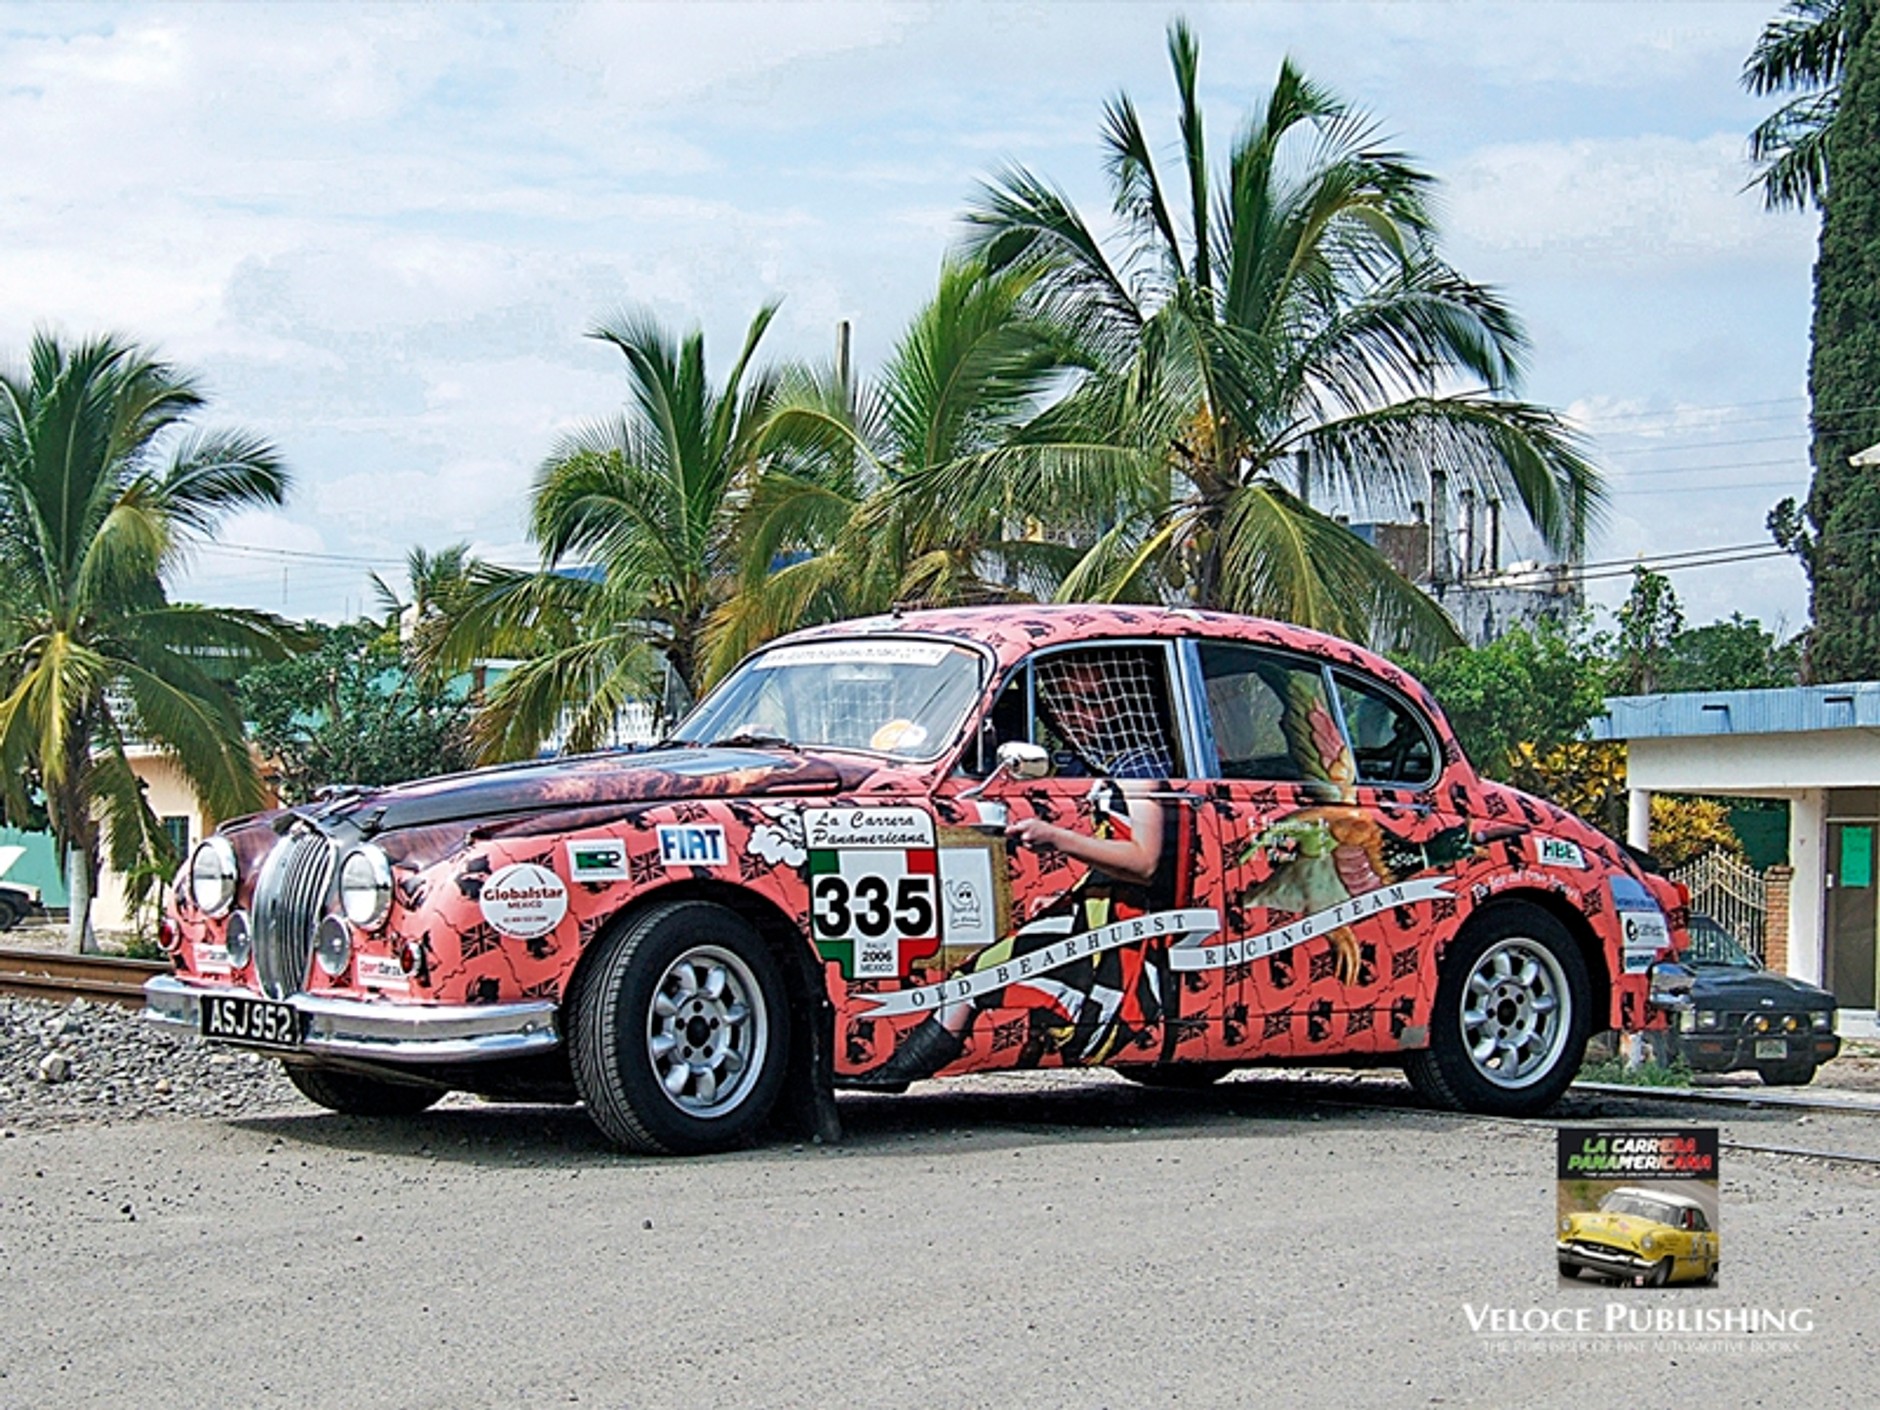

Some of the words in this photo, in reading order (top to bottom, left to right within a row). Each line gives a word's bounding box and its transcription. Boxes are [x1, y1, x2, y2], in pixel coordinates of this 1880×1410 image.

[815, 811, 839, 827] La
[850, 811, 914, 829] Carrera
[660, 829, 721, 861] FIAT
[812, 828, 930, 845] Panamericana
[483, 886, 564, 901] Globalstar
[814, 876, 933, 937] 335
[1204, 922, 1314, 966] RACING
[1333, 885, 1406, 923] TEAM
[861, 950, 893, 962] 2006
[911, 979, 972, 1007] OLD
[996, 913, 1187, 984] BEARHURST
[860, 963, 895, 972] MEXICO
